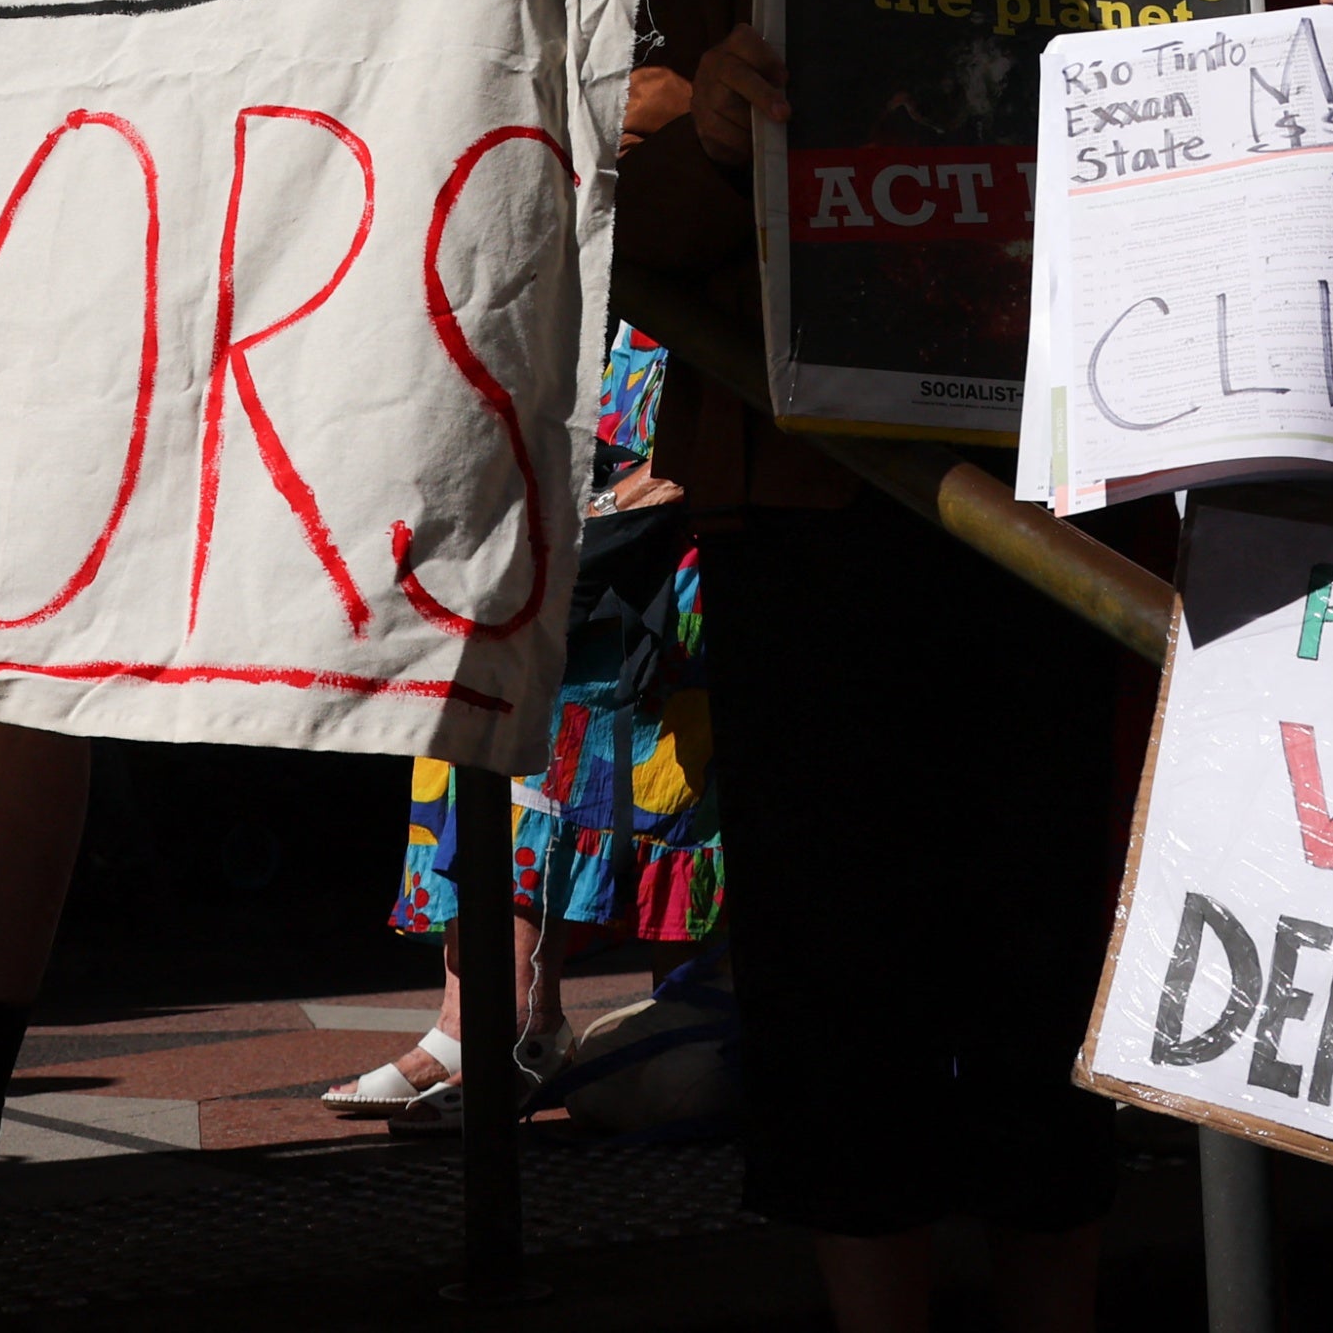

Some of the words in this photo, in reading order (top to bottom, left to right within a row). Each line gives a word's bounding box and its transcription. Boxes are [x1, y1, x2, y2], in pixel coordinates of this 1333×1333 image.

[1062, 60, 1133, 96] Rio
[1142, 31, 1247, 77] Tinto
[1070, 128, 1212, 184] State
[808, 164, 994, 227] ACT
